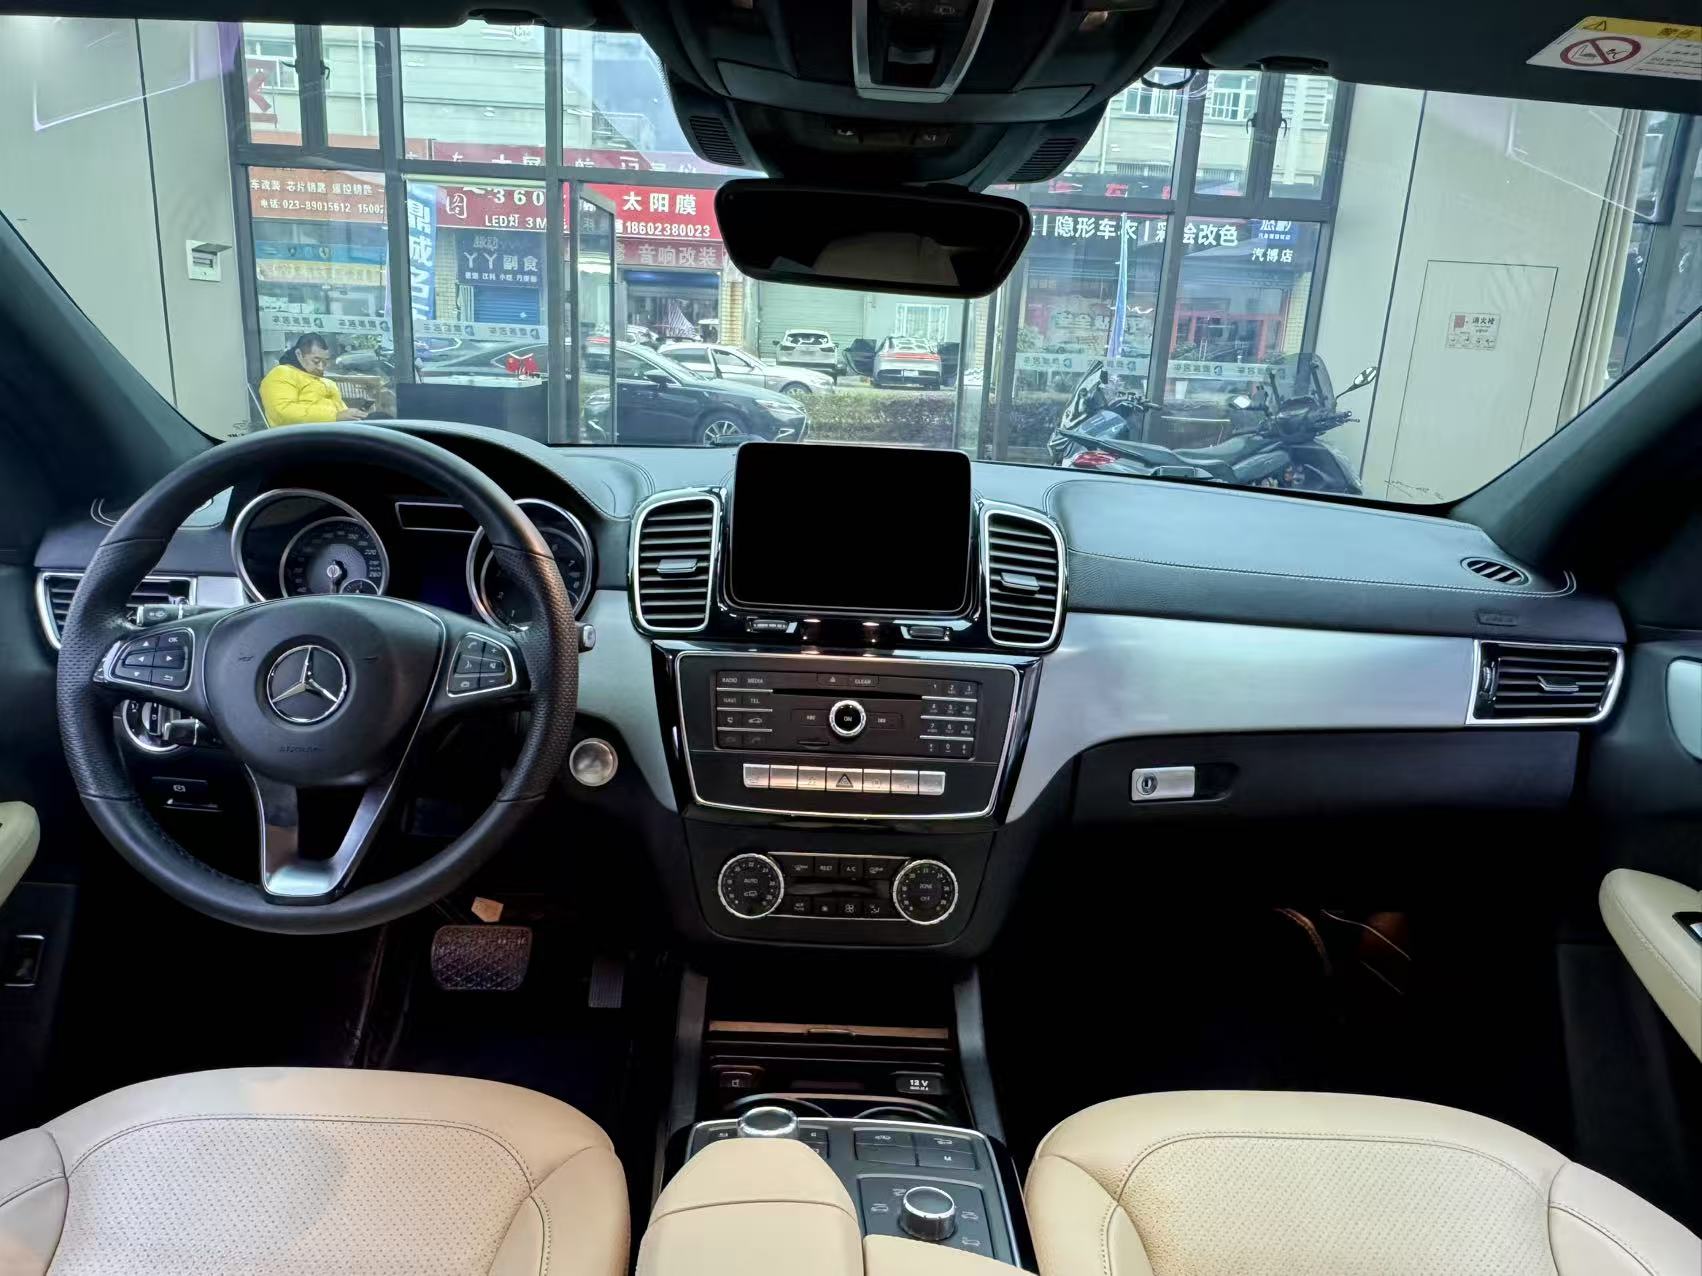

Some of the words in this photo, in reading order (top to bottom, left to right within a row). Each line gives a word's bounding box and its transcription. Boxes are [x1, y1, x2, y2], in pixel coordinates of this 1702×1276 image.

[623, 191, 697, 215] 太阳膜
[625, 221, 711, 237] 18602380023
[638, 244, 717, 267] 音响改装
[1251, 248, 1293, 263] 汽博店
